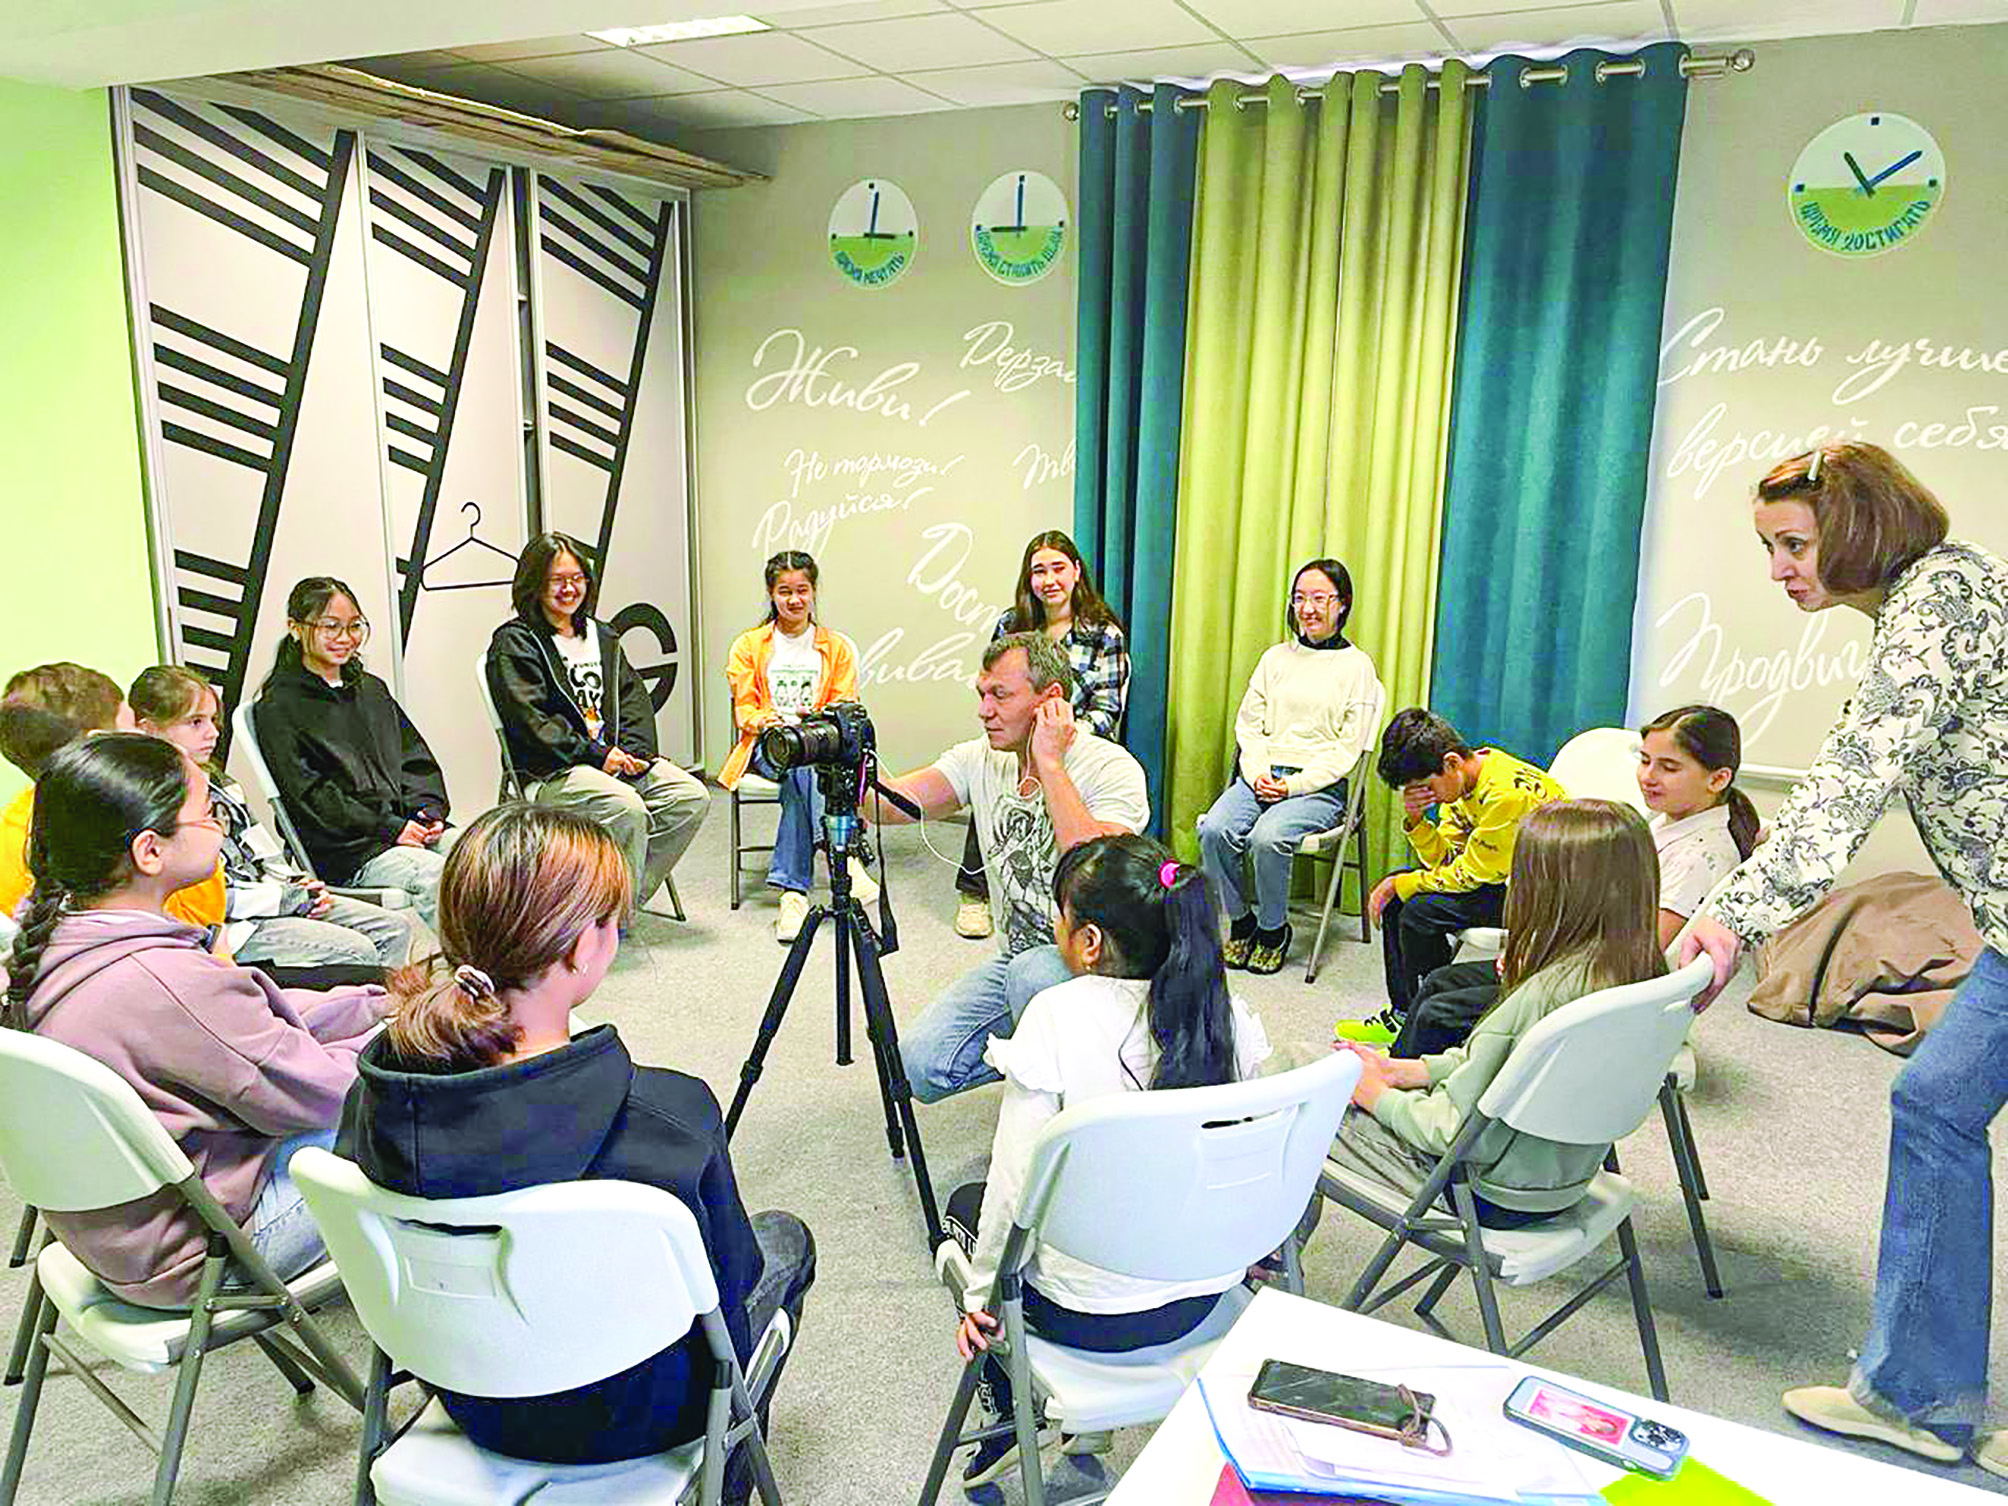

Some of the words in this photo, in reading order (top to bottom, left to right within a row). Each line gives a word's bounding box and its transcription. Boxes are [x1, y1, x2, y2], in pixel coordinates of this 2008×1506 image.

[746, 329, 971, 427] Живи!
[1656, 307, 1822, 386] Стань
[784, 449, 827, 498] Не
